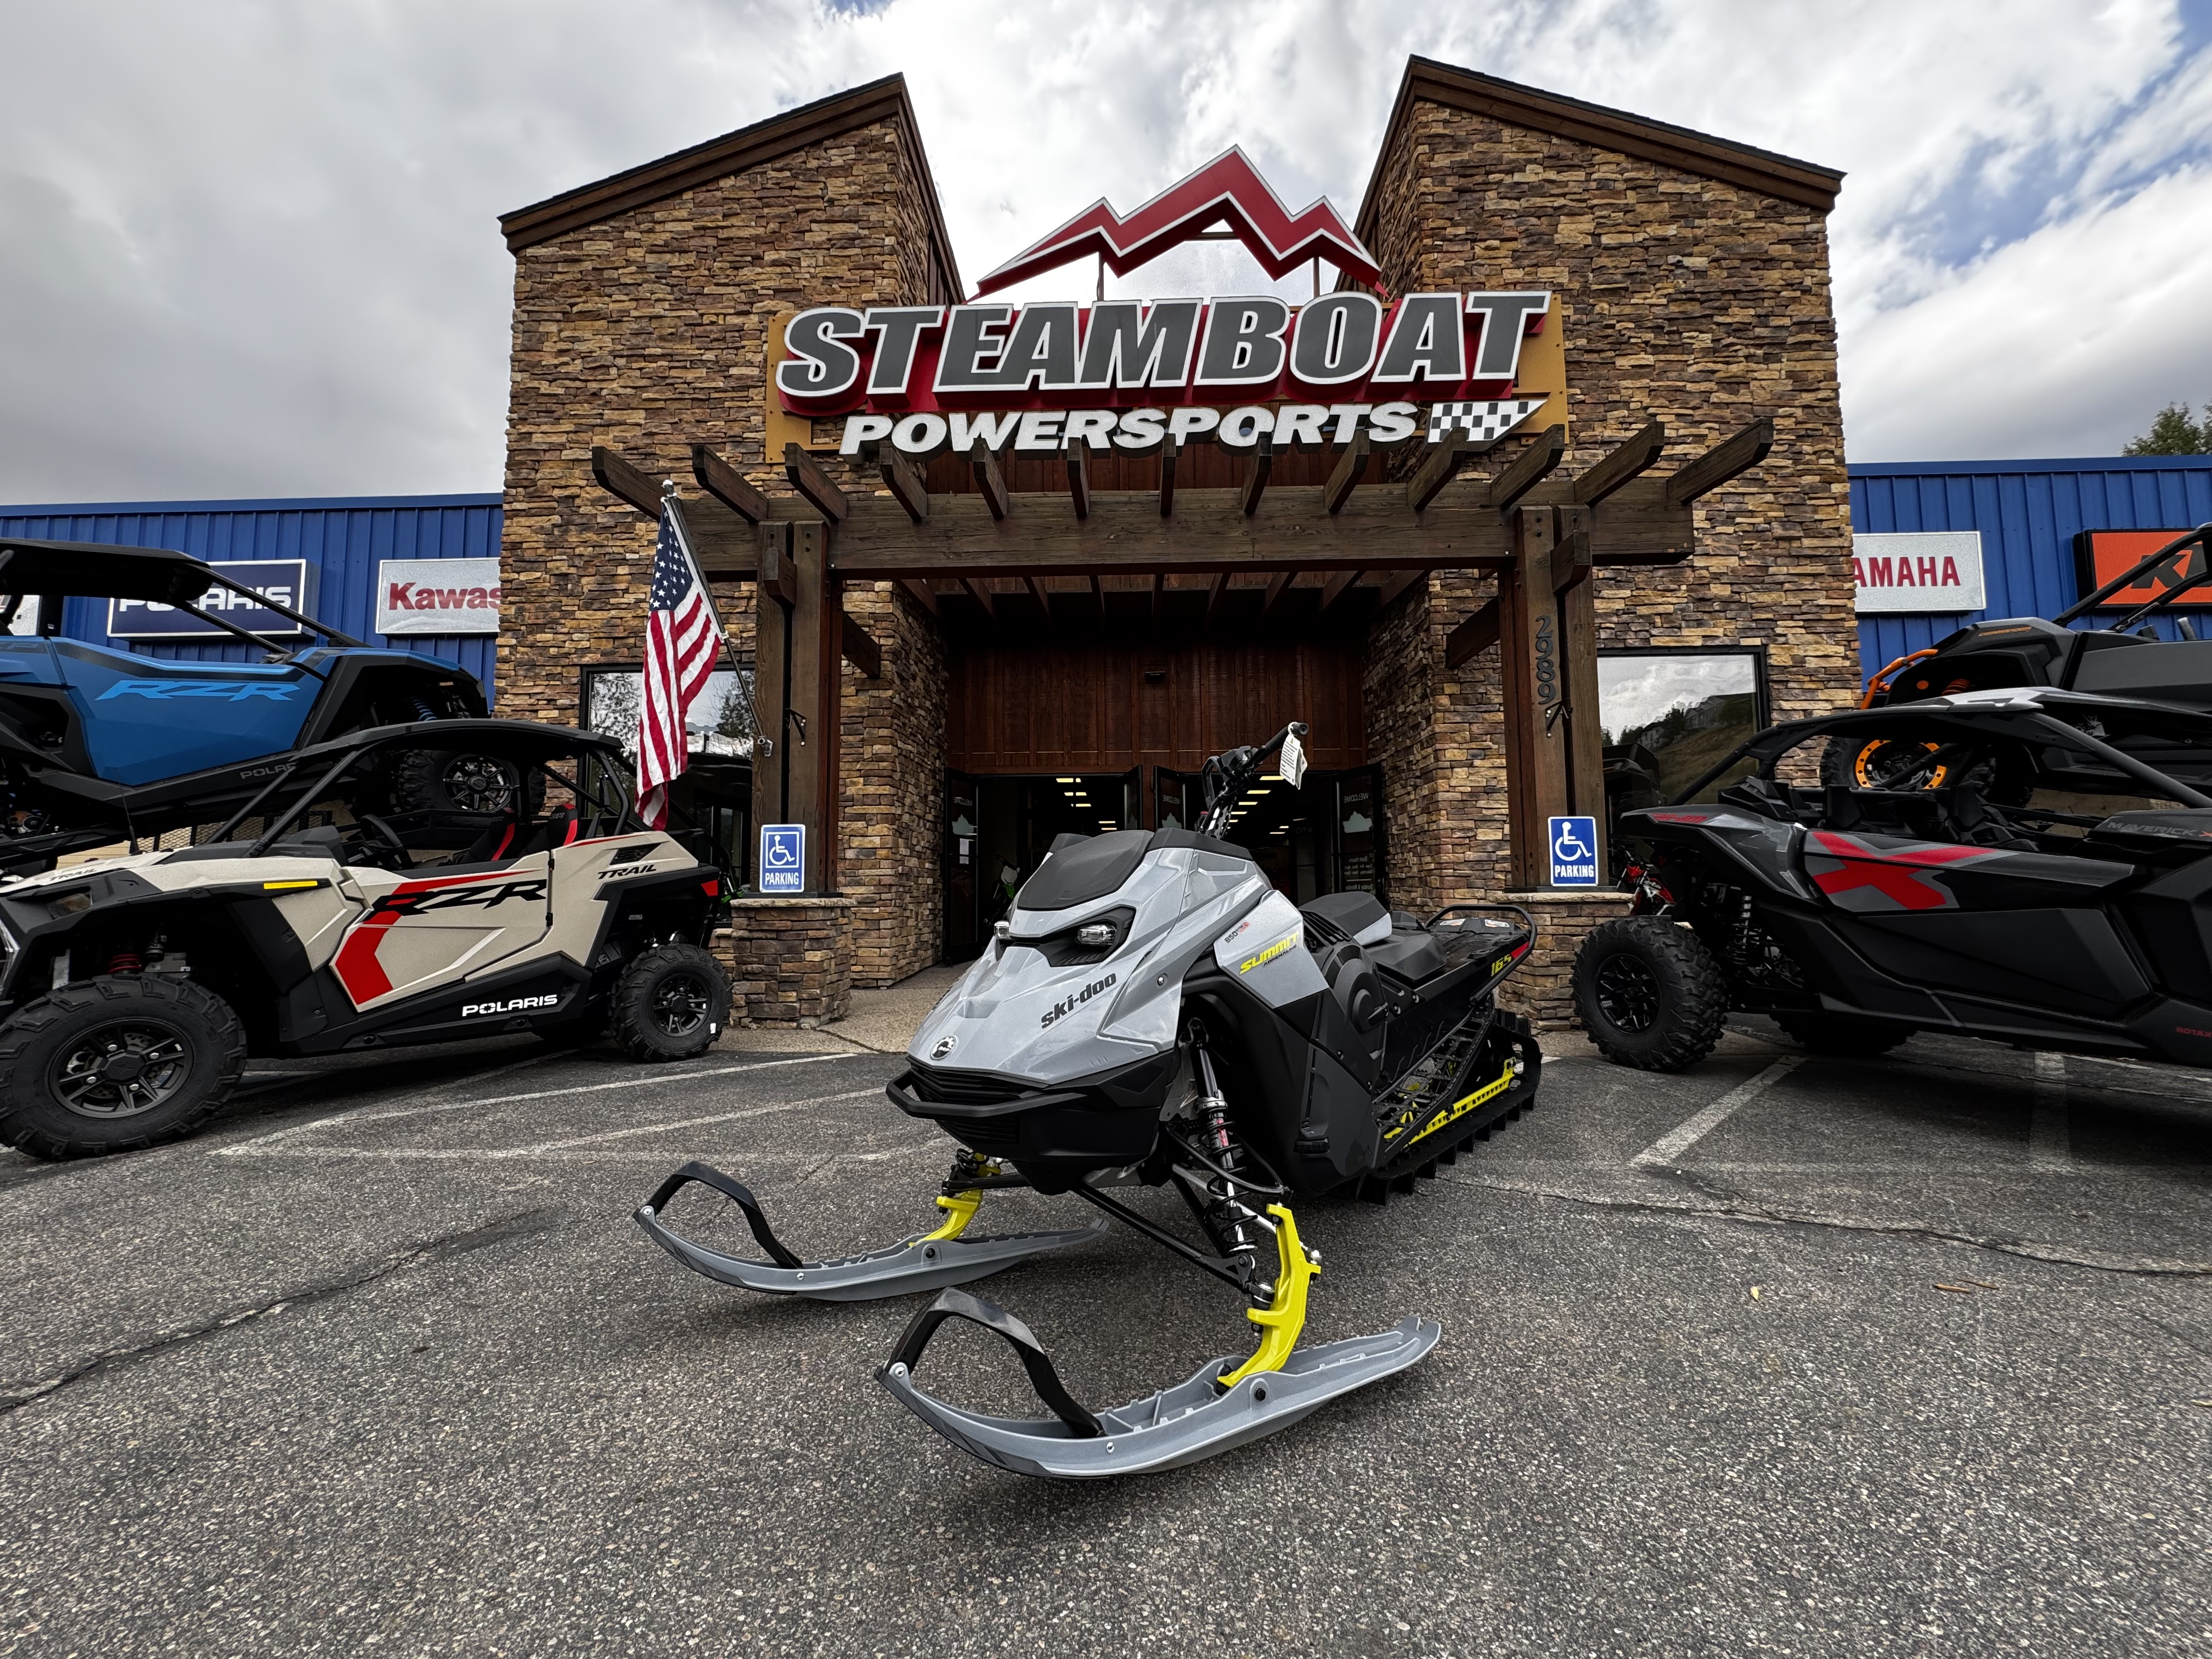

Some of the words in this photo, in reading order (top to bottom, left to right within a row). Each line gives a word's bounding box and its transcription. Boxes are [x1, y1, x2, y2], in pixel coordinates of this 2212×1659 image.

[775, 291, 1551, 397] STEAMBOAT
[839, 401, 1418, 455] POWERSPORTS
[1536, 615, 1556, 705] 2989
[94, 680, 301, 702] RZR
[2107, 822, 2198, 836] MAVERICK
[597, 864, 657, 880] TRAIL
[765, 872, 799, 885] PARKING
[1554, 865, 1595, 878] PARKING
[362, 879, 547, 924] RZR
[1224, 931, 1239, 944] 850
[1239, 930, 1300, 975] SUMMIT
[462, 994, 558, 1017] POLARIS
[1041, 973, 1117, 1029] ski-doo
